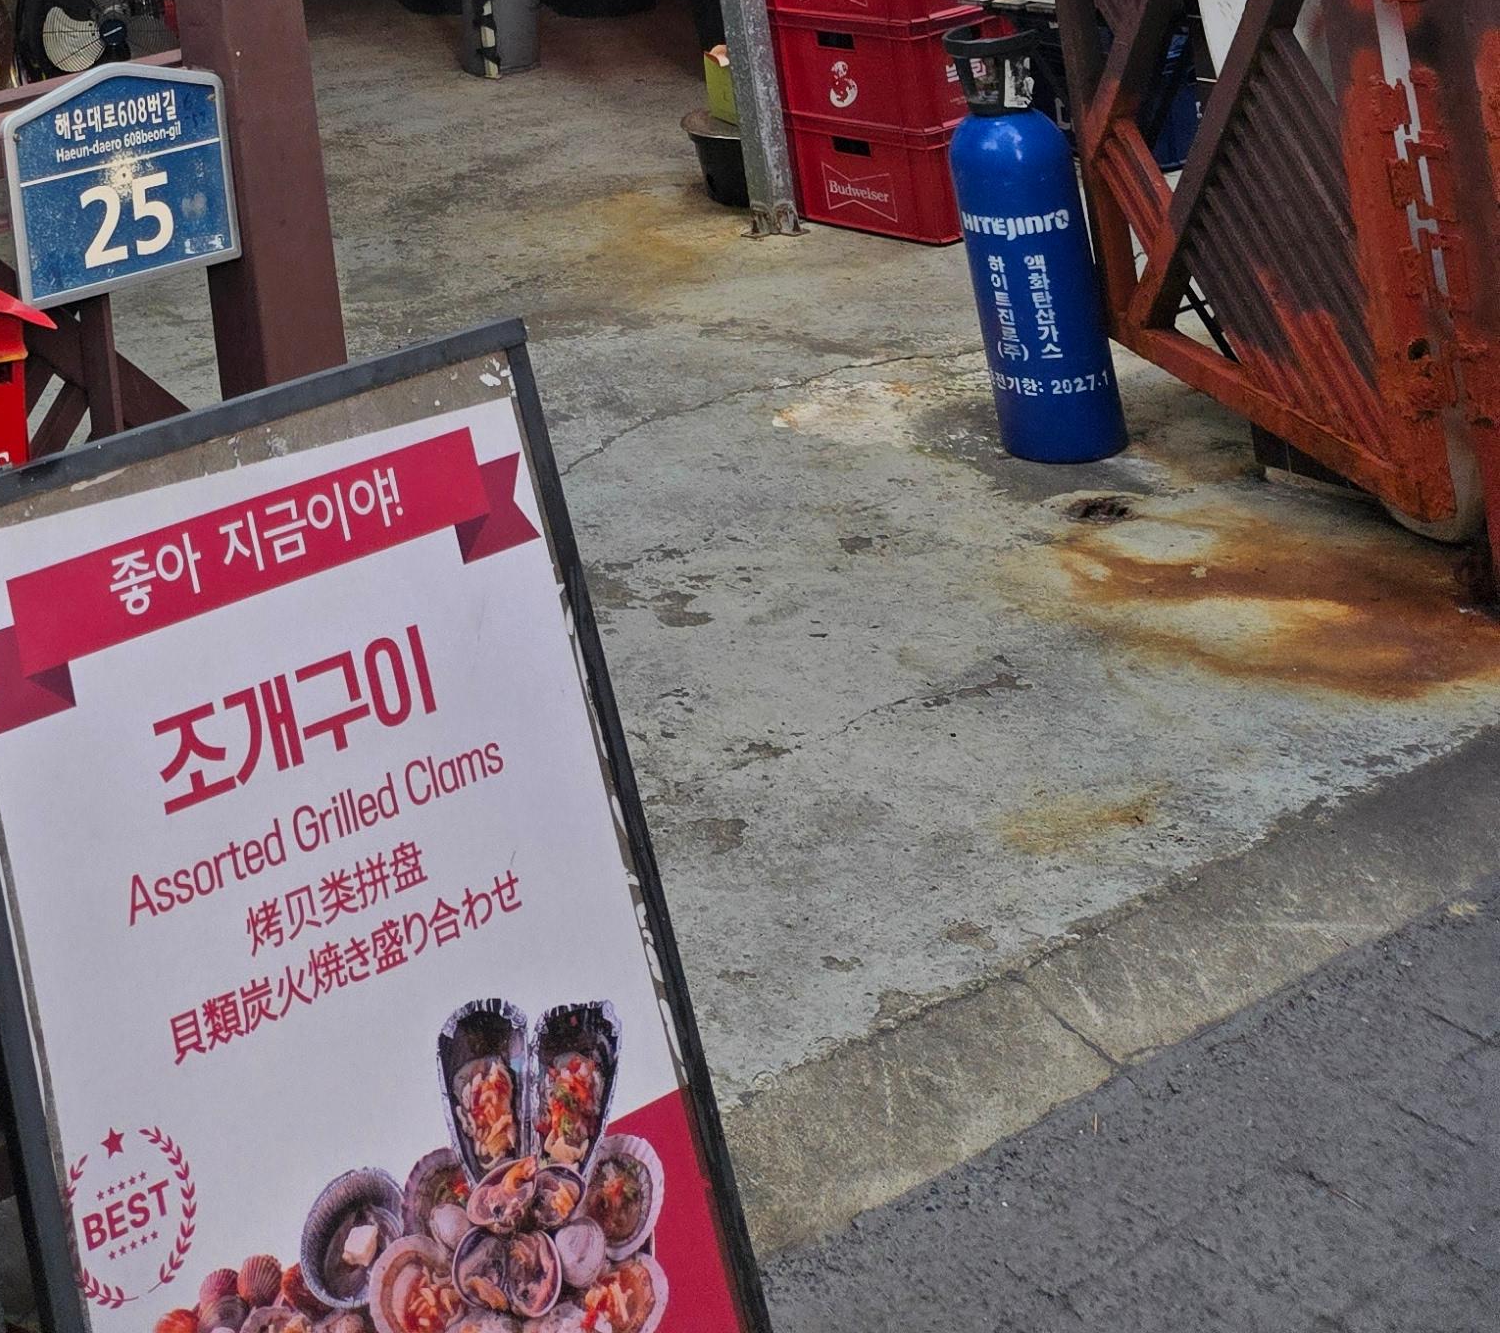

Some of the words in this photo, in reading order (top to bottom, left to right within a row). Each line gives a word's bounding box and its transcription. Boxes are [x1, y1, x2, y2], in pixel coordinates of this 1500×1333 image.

[54, 89, 177, 141] 해운대로608번길
[56, 136, 122, 163] Haeun-daero
[124, 120, 182, 148] 608beon-gil
[80, 171, 175, 269] 25
[828, 180, 889, 203] Budweiser
[109, 538, 203, 615] 좋아
[219, 467, 405, 575] 지금이야!
[152, 624, 440, 816] 조개구이
[127, 818, 287, 925] Assorted
[292, 772, 400, 854] Grilled
[404, 738, 506, 812] Clams
[245, 840, 430, 957] 烤贝类拼盘
[169, 870, 524, 1066] 貝類炭火焼き盛り合わせ
[82, 1179, 170, 1251] BEST
